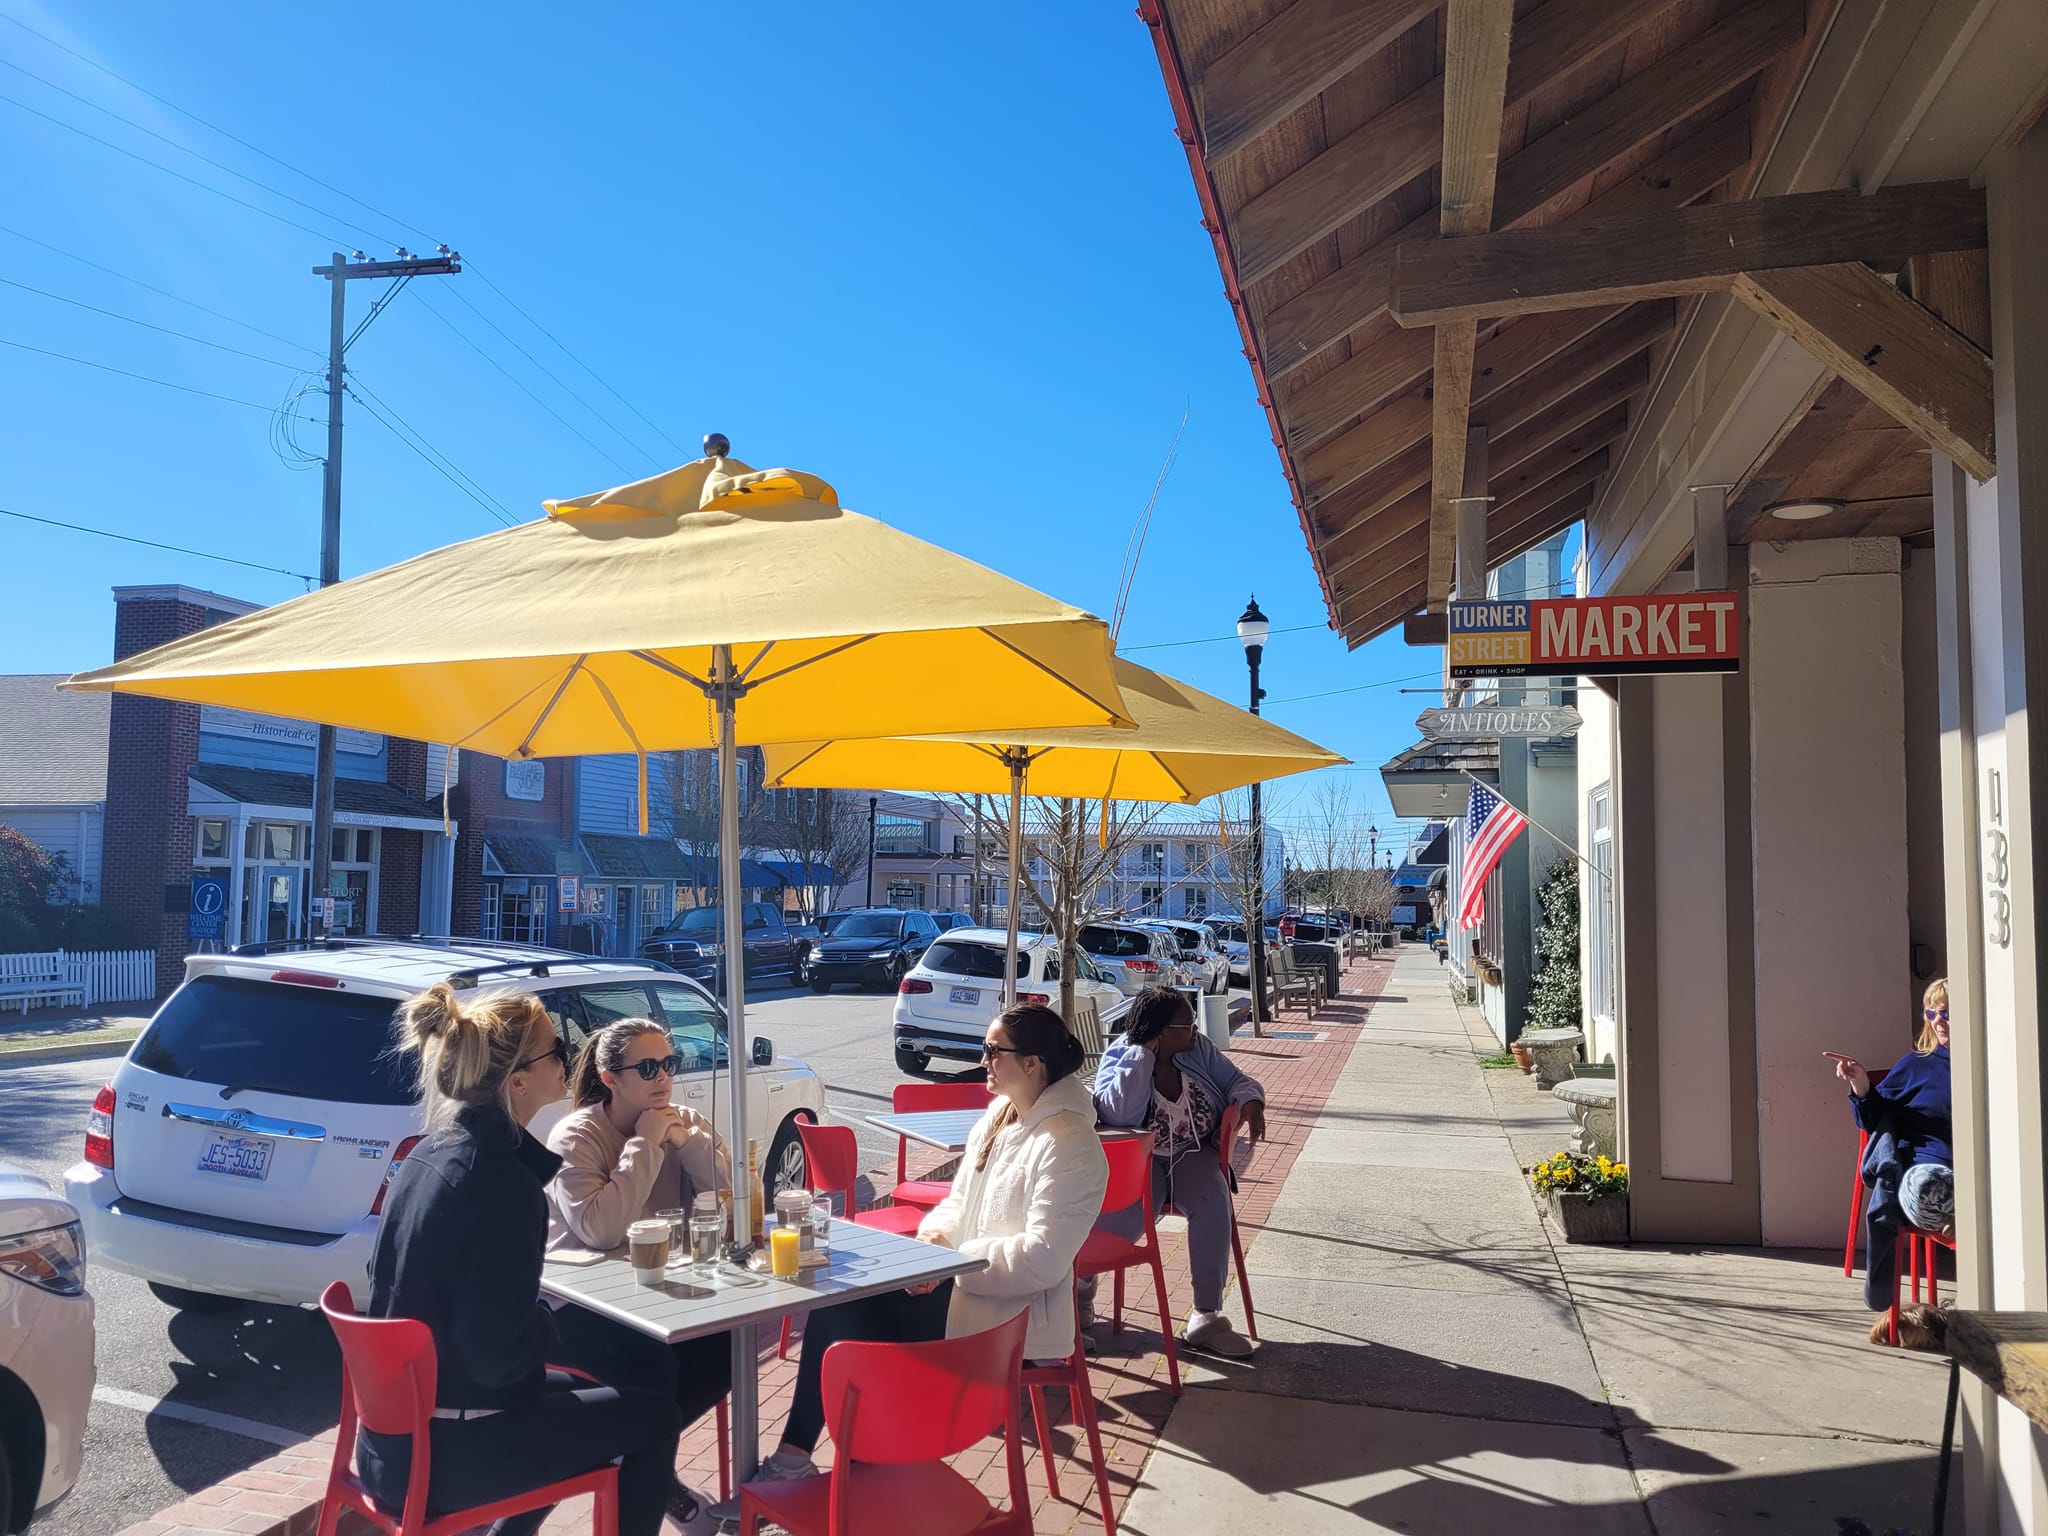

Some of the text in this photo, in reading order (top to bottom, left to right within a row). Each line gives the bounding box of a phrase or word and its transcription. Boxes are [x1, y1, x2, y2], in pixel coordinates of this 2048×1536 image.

[1452, 604, 1527, 628] TURNER
[1540, 601, 1735, 658] MARKET
[1453, 636, 1527, 661] STREET
[252, 723, 302, 740] Historical
[1440, 712, 1552, 735] ANTIQUES
[191, 914, 223, 922] WELCOME
[333, 1136, 390, 1148] HIGHLANDER
[202, 1144, 267, 1171] JES-5033
[202, 1163, 261, 1178] NORTH CAROLINA
